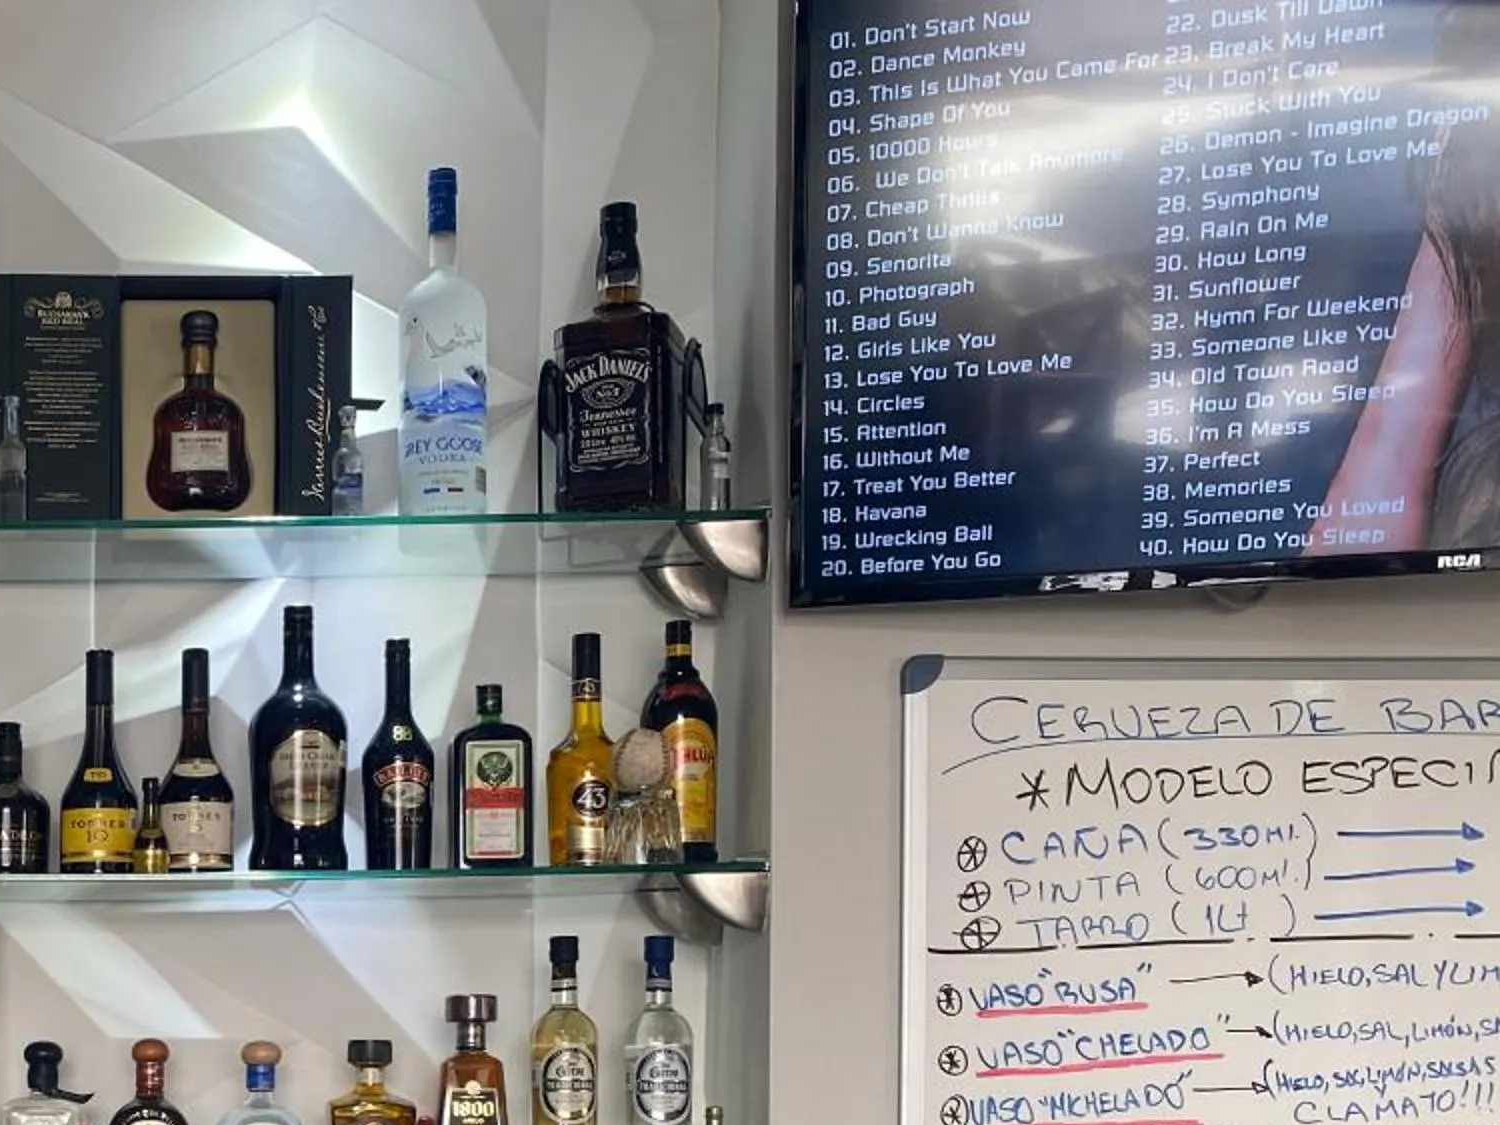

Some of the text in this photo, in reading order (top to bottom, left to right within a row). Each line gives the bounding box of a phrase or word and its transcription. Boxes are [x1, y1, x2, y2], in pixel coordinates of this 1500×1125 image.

[830, 11, 1031, 48] 01. Don't Start Now
[830, 40, 1026, 78] 02. Dance Monkey
[830, 89, 860, 106] 03.
[870, 83, 912, 102] This
[947, 72, 1001, 93] What
[1010, 66, 1047, 85] You
[1056, 59, 1116, 79] Came
[1125, 52, 1159, 70] For
[829, 102, 1011, 136] 04. Shape Of You
[1158, 184, 1319, 214] 28. Symphony
[1156, 212, 1328, 245] 29. Rain On Me
[826, 262, 858, 278] 09.
[1155, 245, 1306, 272] 30. How Long
[826, 278, 974, 306] 10. Photograph
[1153, 275, 1300, 302] 31. Sunflower
[825, 310, 936, 334] 11. Bad Guy
[824, 333, 996, 362] 12. Girls Like You
[824, 354, 1071, 389] 13. Lose You To Love Me
[824, 396, 924, 416] 14. Circles
[823, 422, 946, 443] 15. Attention
[823, 446, 970, 470] 16. Without Me
[1143, 451, 1260, 473] 37. Perfect
[823, 471, 1016, 496] 17. Treat You Better
[1143, 478, 1291, 501] 38. Memories
[822, 505, 926, 524] 18. Havana
[822, 525, 992, 550] 19. Wrecking Ball
[822, 552, 1001, 576] 20. Before You Go
[1438, 553, 1482, 568] RCA
[971, 696, 1251, 744] CERVEZA
[1270, 699, 1346, 737] DE
[577, 783, 607, 809] 43
[969, 983, 1044, 1011] VASO
[977, 1040, 1063, 1070] VASO
[453, 1101, 495, 1117] 1800
